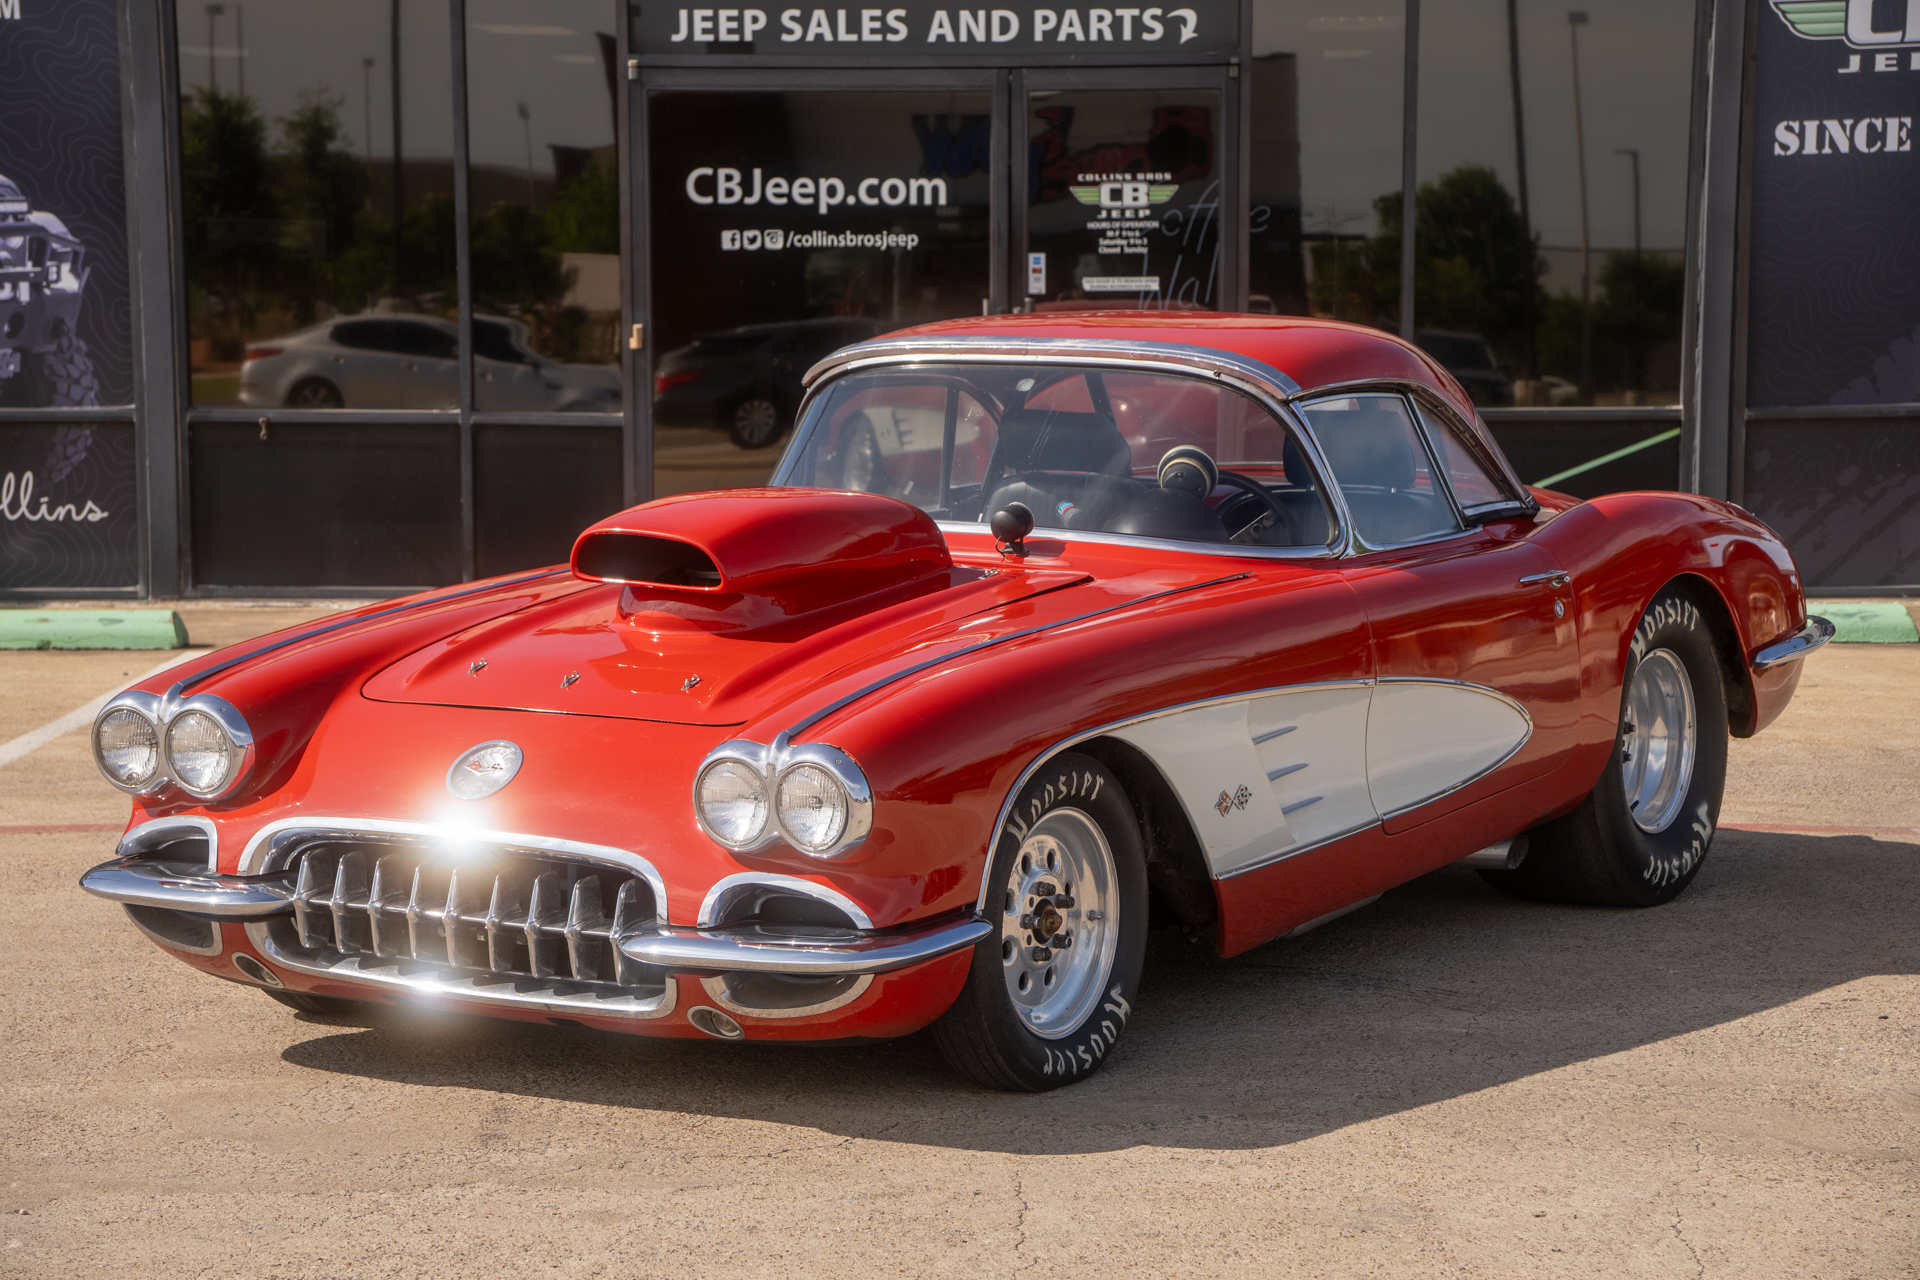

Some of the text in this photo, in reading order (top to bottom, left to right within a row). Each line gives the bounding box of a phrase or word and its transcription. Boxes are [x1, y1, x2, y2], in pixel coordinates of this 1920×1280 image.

[671, 8, 1164, 42] JEEP SALES AND PARTS
[1774, 117, 1911, 156] SINCE
[1077, 172, 1172, 182] COLLINS BROS
[686, 167, 947, 214] CBJeep.com
[1100, 182, 1150, 208] CB
[1097, 209, 1151, 219] JEEP
[1086, 220, 1160, 230] HOURS OF OPERATION
[786, 229, 919, 251] /collinsbrosjeep
[1098, 237, 1128, 246] Saturday
[1098, 245, 1149, 254] Closed Sunday
